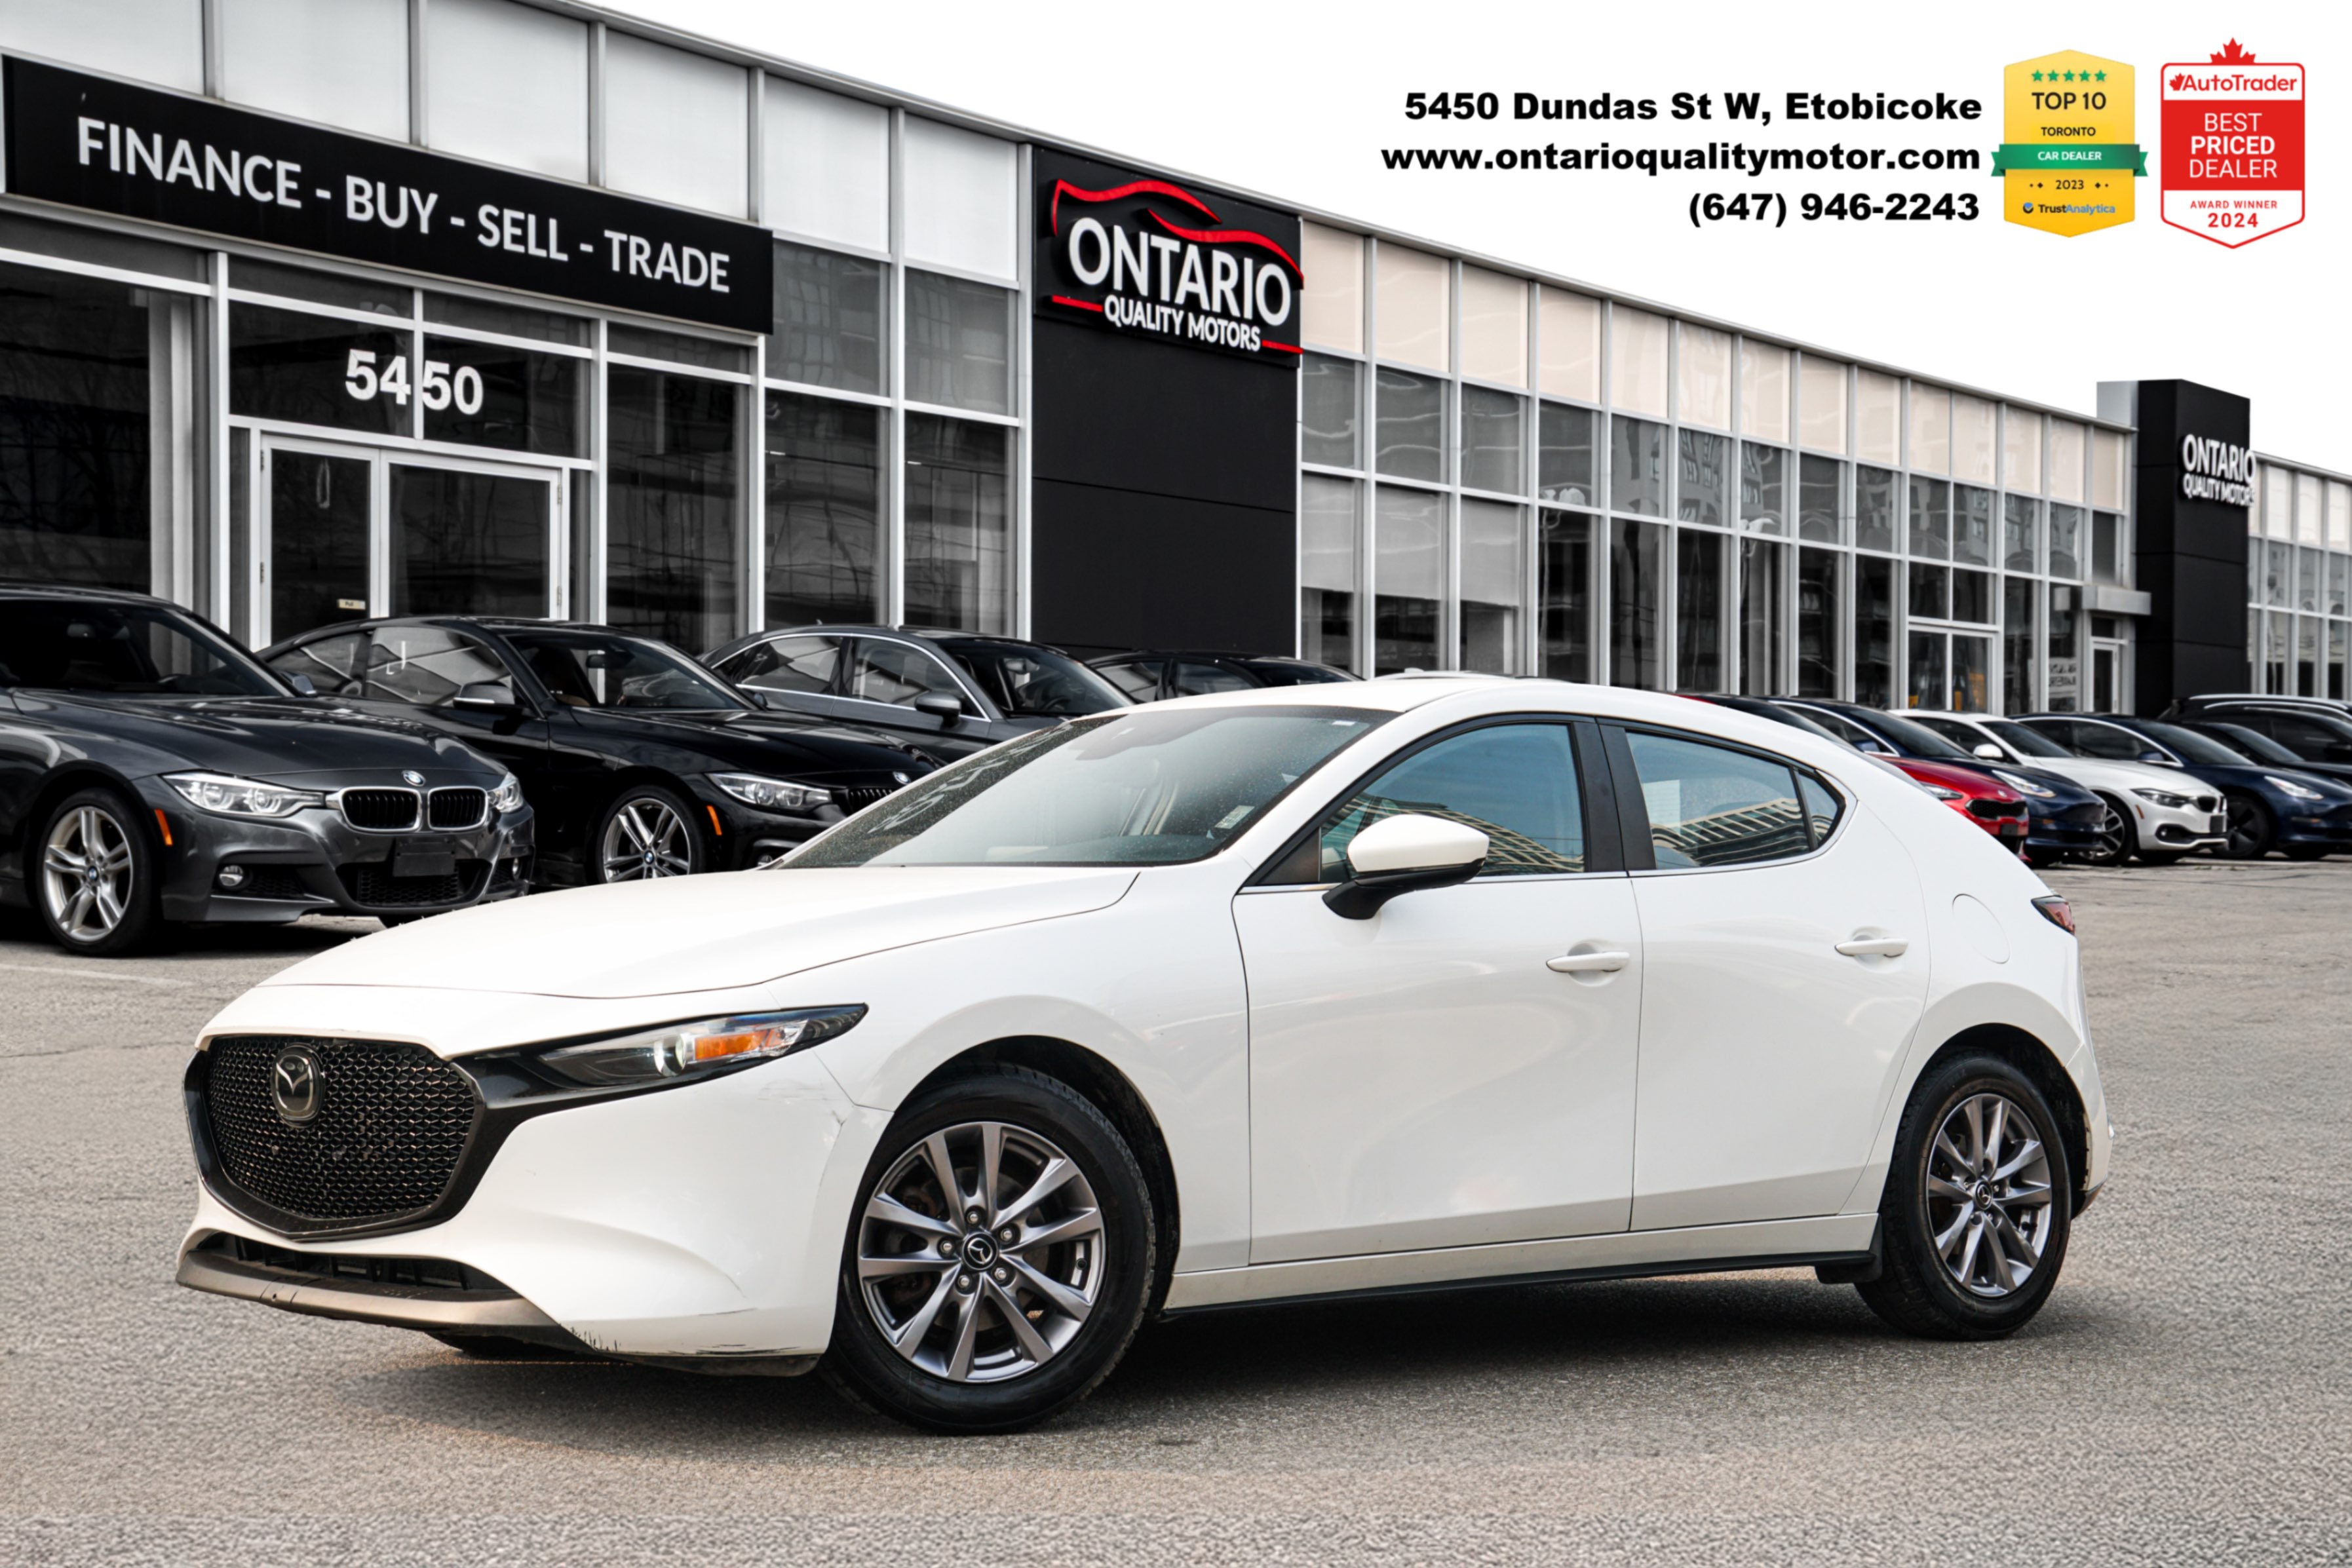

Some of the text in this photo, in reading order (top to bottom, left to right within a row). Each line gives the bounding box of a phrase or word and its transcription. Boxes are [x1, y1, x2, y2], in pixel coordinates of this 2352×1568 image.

[77, 116, 729, 293] FINANCE - BUY - SELL - TRADE
[1069, 217, 1291, 326] ONTARIO
[1104, 294, 1262, 352] QUALITY MOTORS
[345, 349, 484, 415] 5450
[2183, 434, 2256, 486] ONTARIO
[2183, 472, 2220, 500] QUALITY
